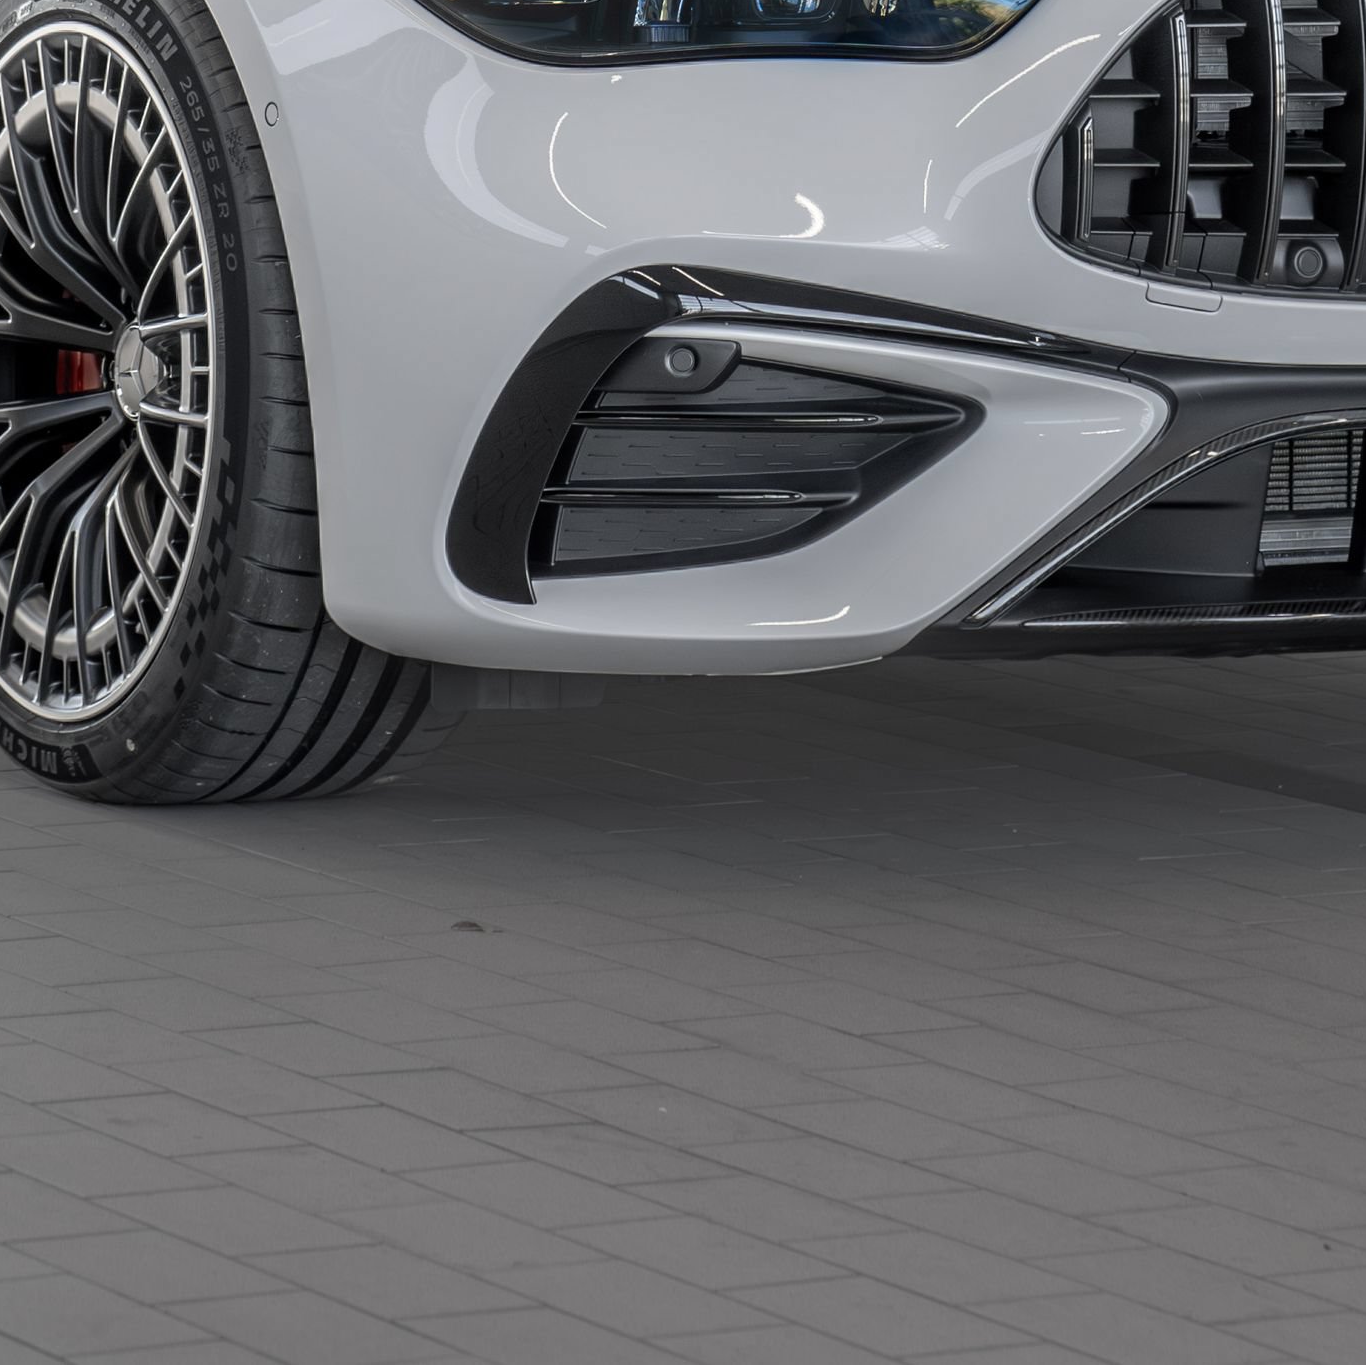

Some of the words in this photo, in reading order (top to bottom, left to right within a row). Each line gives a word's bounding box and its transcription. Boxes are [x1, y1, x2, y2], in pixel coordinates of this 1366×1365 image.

[180, 76, 221, 172] 265/35
[213, 183, 231, 219] ZR
[222, 234, 238, 272] 20
